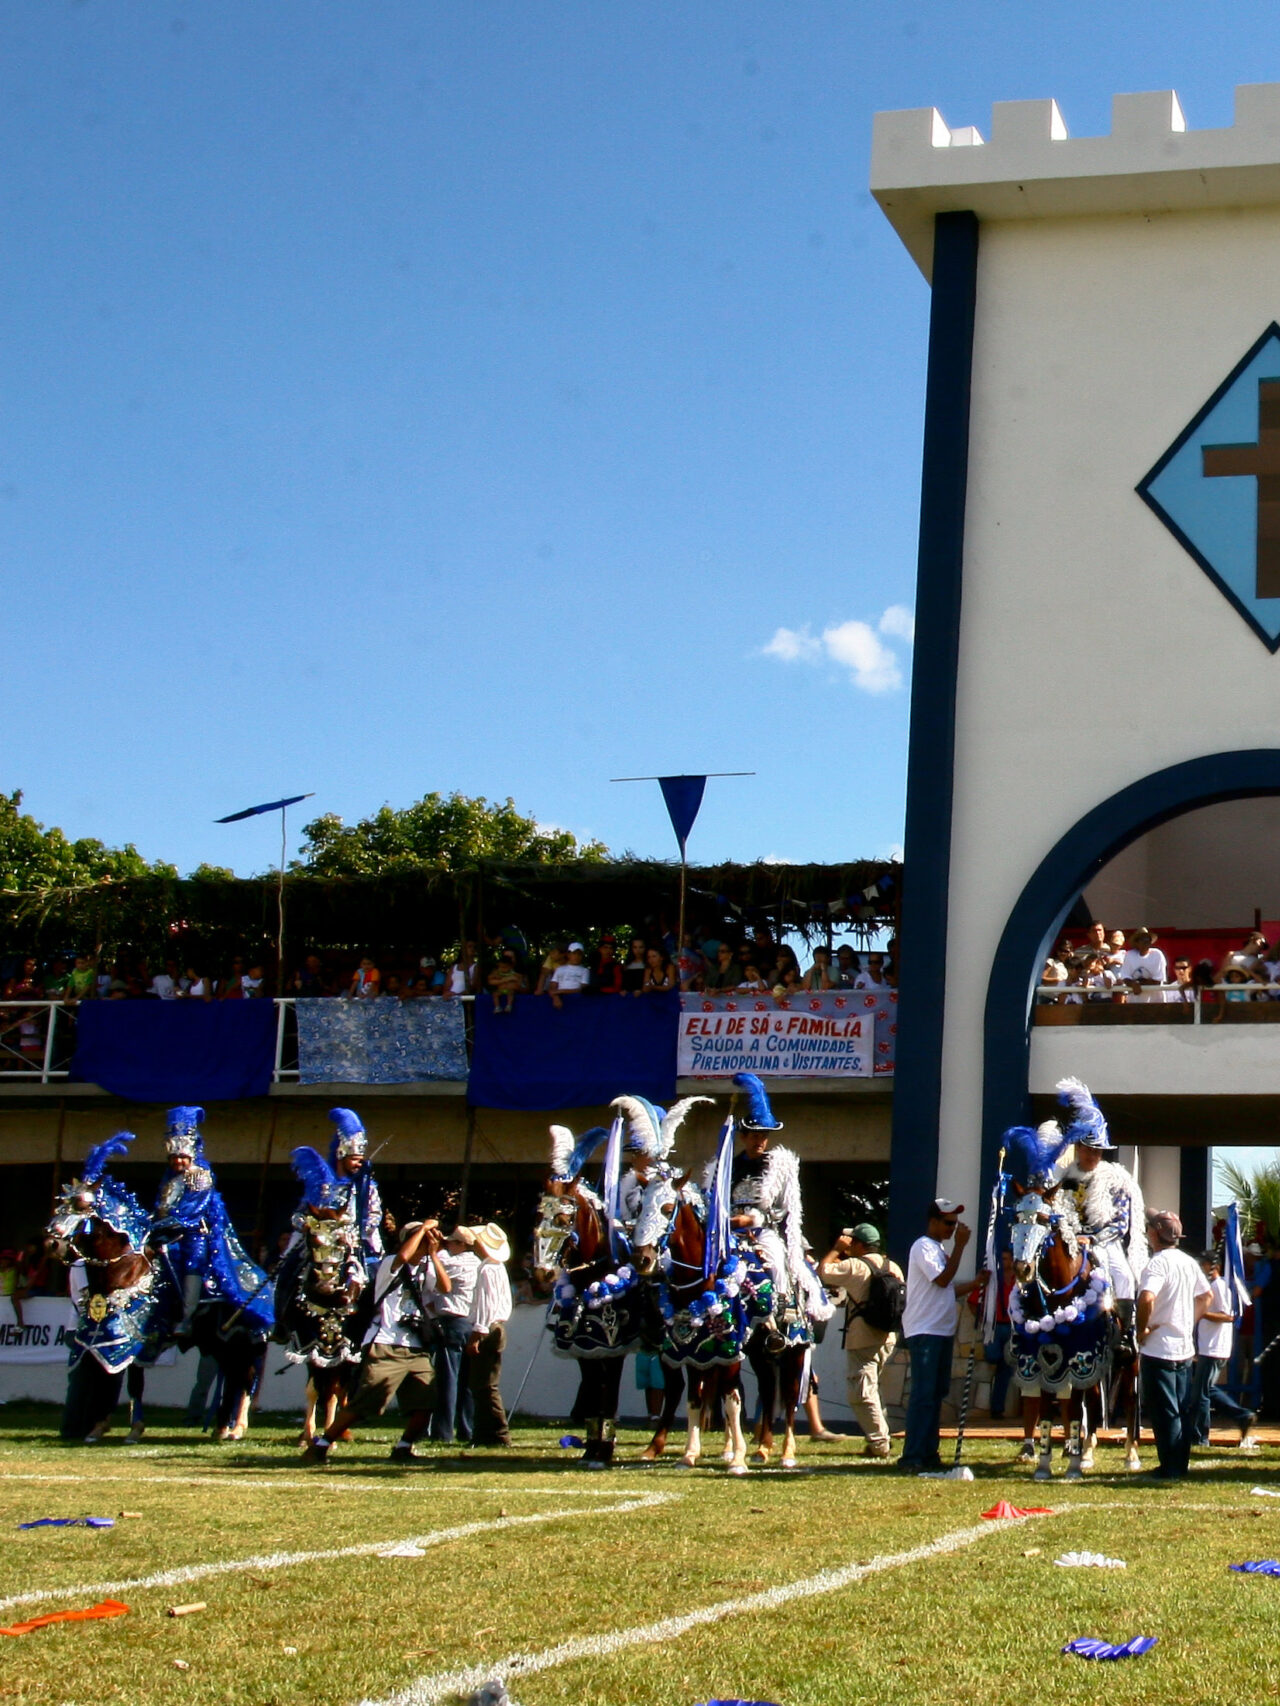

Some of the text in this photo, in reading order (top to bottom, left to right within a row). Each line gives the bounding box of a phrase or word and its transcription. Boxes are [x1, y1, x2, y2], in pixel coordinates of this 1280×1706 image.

[685, 1017, 722, 1036] ELI
[725, 1016, 747, 1035] DE
[749, 1012, 771, 1036] SÁ
[749, 1037, 760, 1053] A
[765, 1034, 856, 1054] COMUNIDADE
[691, 1052, 780, 1071] PIRENOPOLINA
[790, 1052, 863, 1072] VISITANTES.
